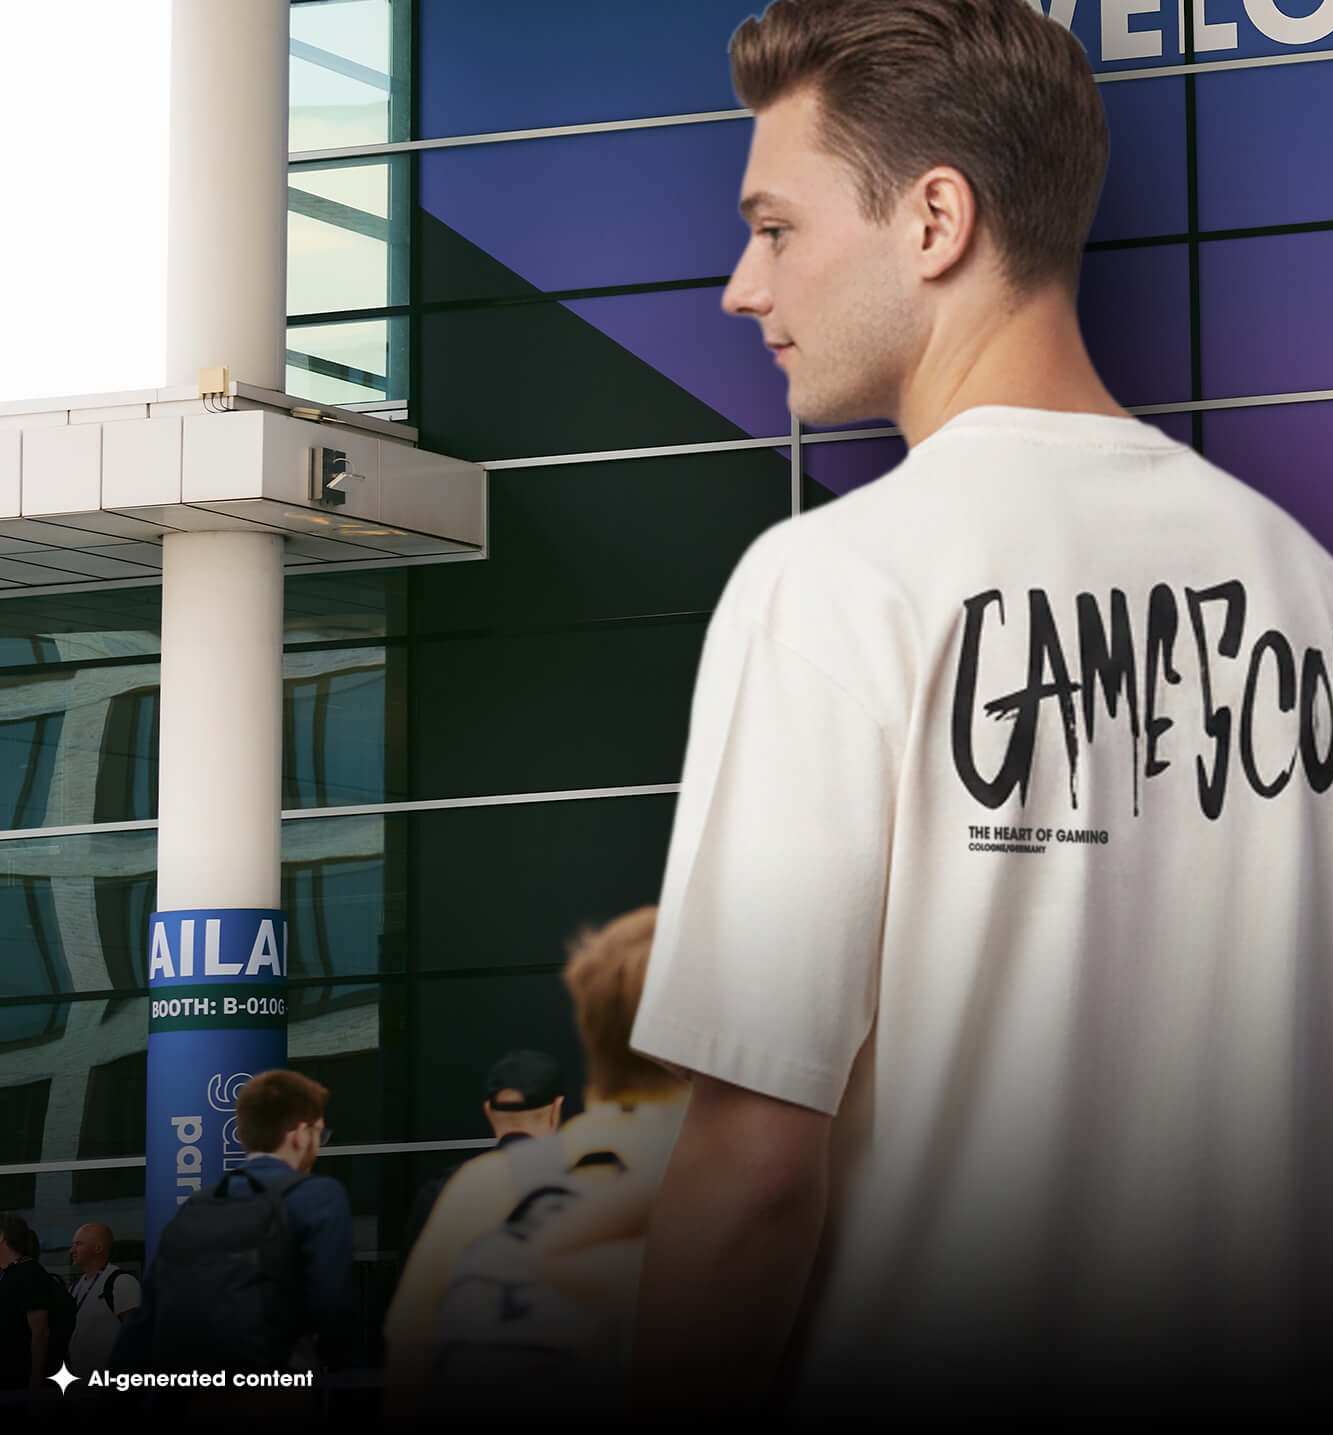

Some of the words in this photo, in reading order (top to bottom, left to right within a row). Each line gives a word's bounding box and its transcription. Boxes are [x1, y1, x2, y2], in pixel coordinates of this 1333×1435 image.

[968, 826, 990, 839] THE
[994, 826, 1033, 841] HEART
[1036, 828, 1053, 842] OF
[1056, 829, 1109, 845] GAMING
[149, 919, 287, 980] AILA
[152, 998, 217, 1018] BOOTH:
